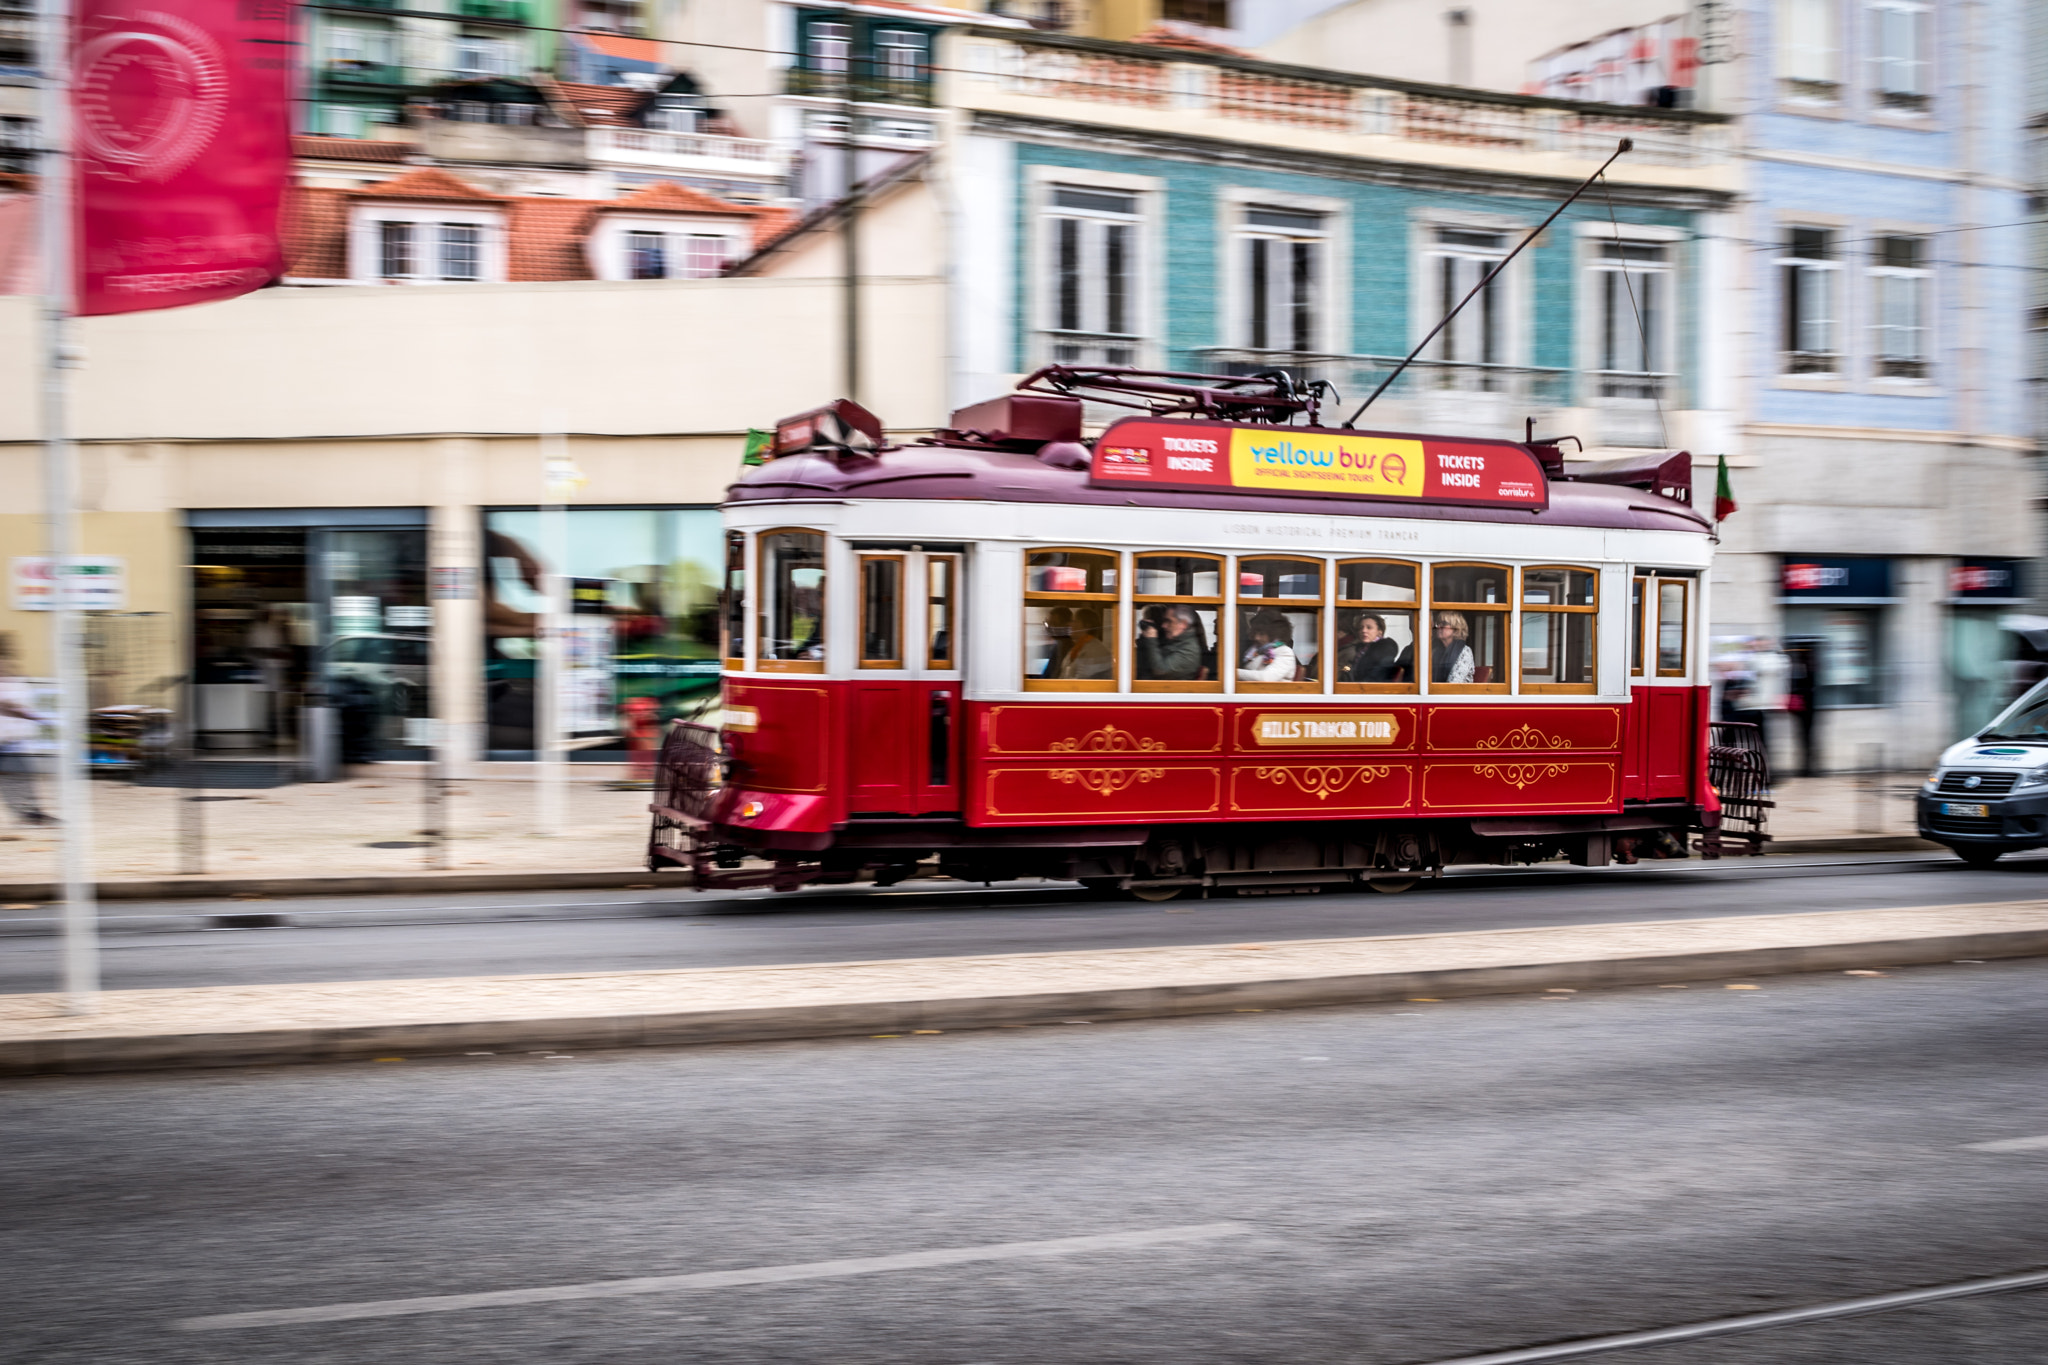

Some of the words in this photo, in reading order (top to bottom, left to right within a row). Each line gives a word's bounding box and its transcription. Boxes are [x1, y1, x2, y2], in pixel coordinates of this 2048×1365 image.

[1250, 441, 1334, 467] yellow
[1339, 445, 1377, 469] bus
[1437, 454, 1485, 471] TICKETS
[1441, 472, 1481, 488] INSIDE
[1378, 529, 1420, 541] TRAMCAR
[1359, 721, 1391, 738] TOUR
